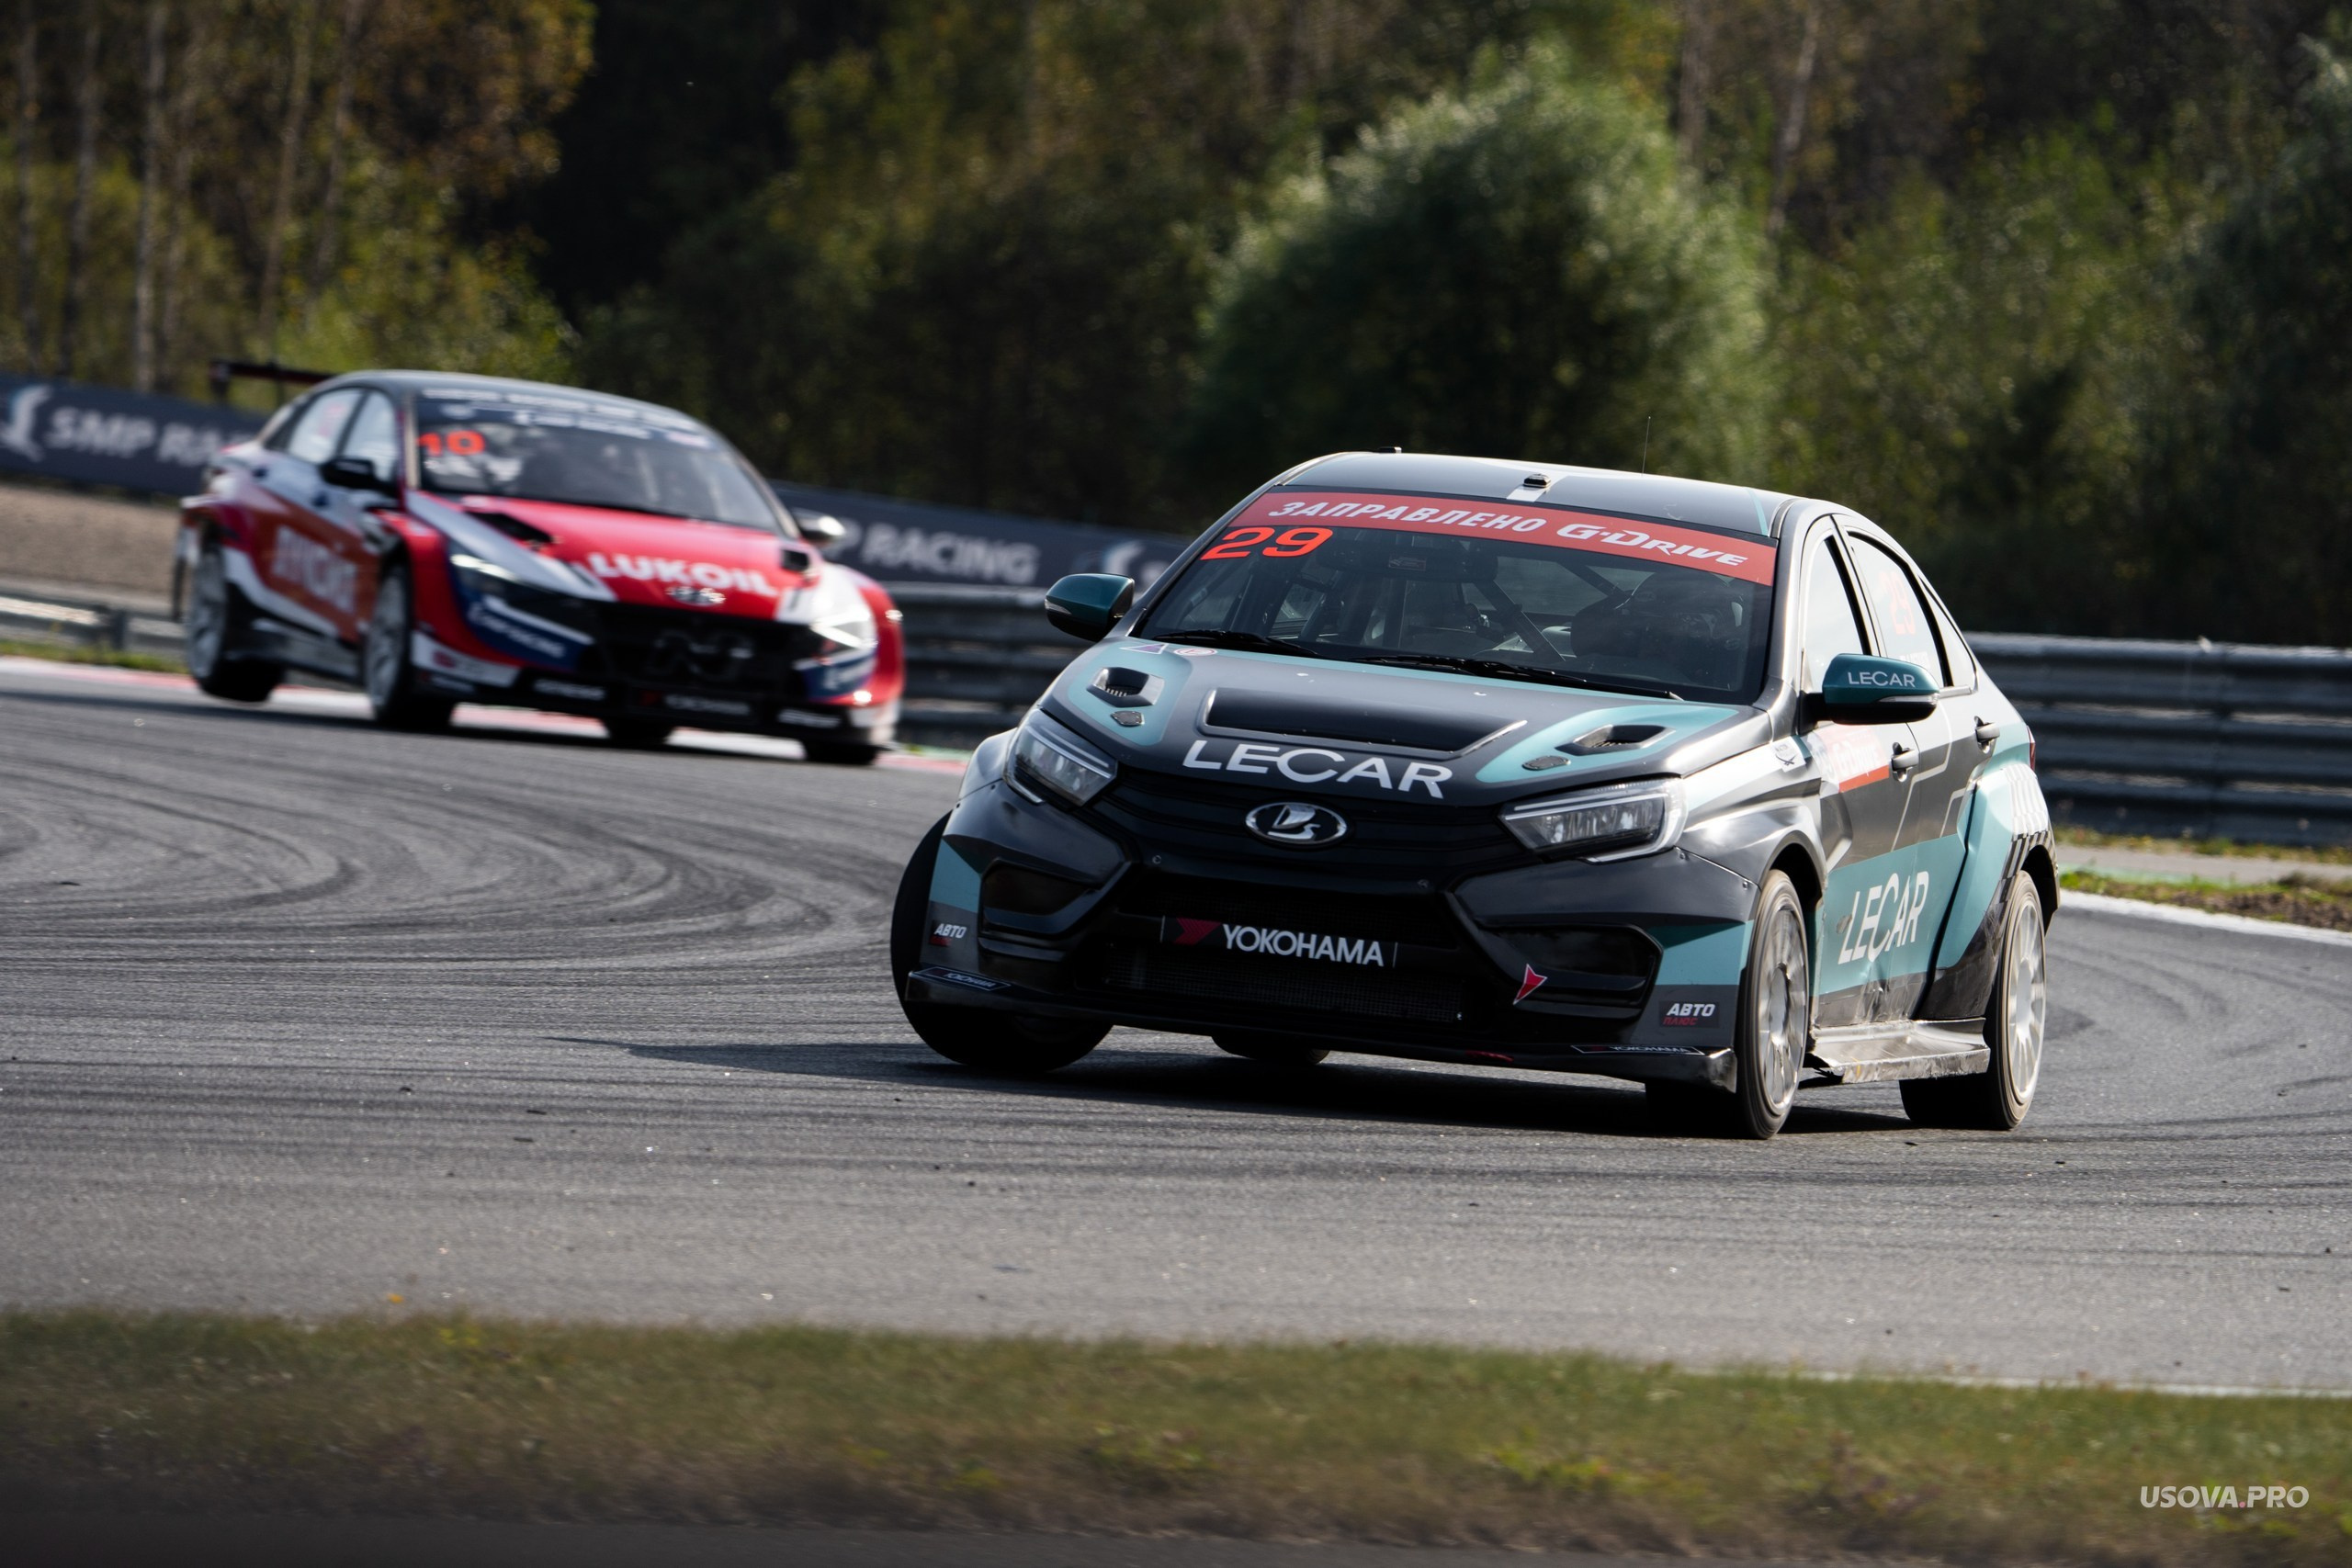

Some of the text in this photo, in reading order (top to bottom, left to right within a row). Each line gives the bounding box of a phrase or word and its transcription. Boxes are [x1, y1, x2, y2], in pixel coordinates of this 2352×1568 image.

[48, 407, 157, 457] SMP
[417, 430, 485, 456] 10
[1268, 502, 1547, 532] ЗАПРАВЛЕНО
[862, 522, 1041, 584] RACING
[1200, 527, 1333, 560] 29
[588, 553, 778, 596] LUKOIL
[1848, 671, 1916, 688] LECAR
[1182, 739, 1453, 799] LECAR
[933, 923, 967, 939] АВТО
[1838, 871, 1929, 964] LECAR
[1223, 923, 1385, 966] YOKOHAMA
[1662, 1017, 1699, 1026] ПЛЮС
[1667, 1003, 1715, 1017] АВТО
